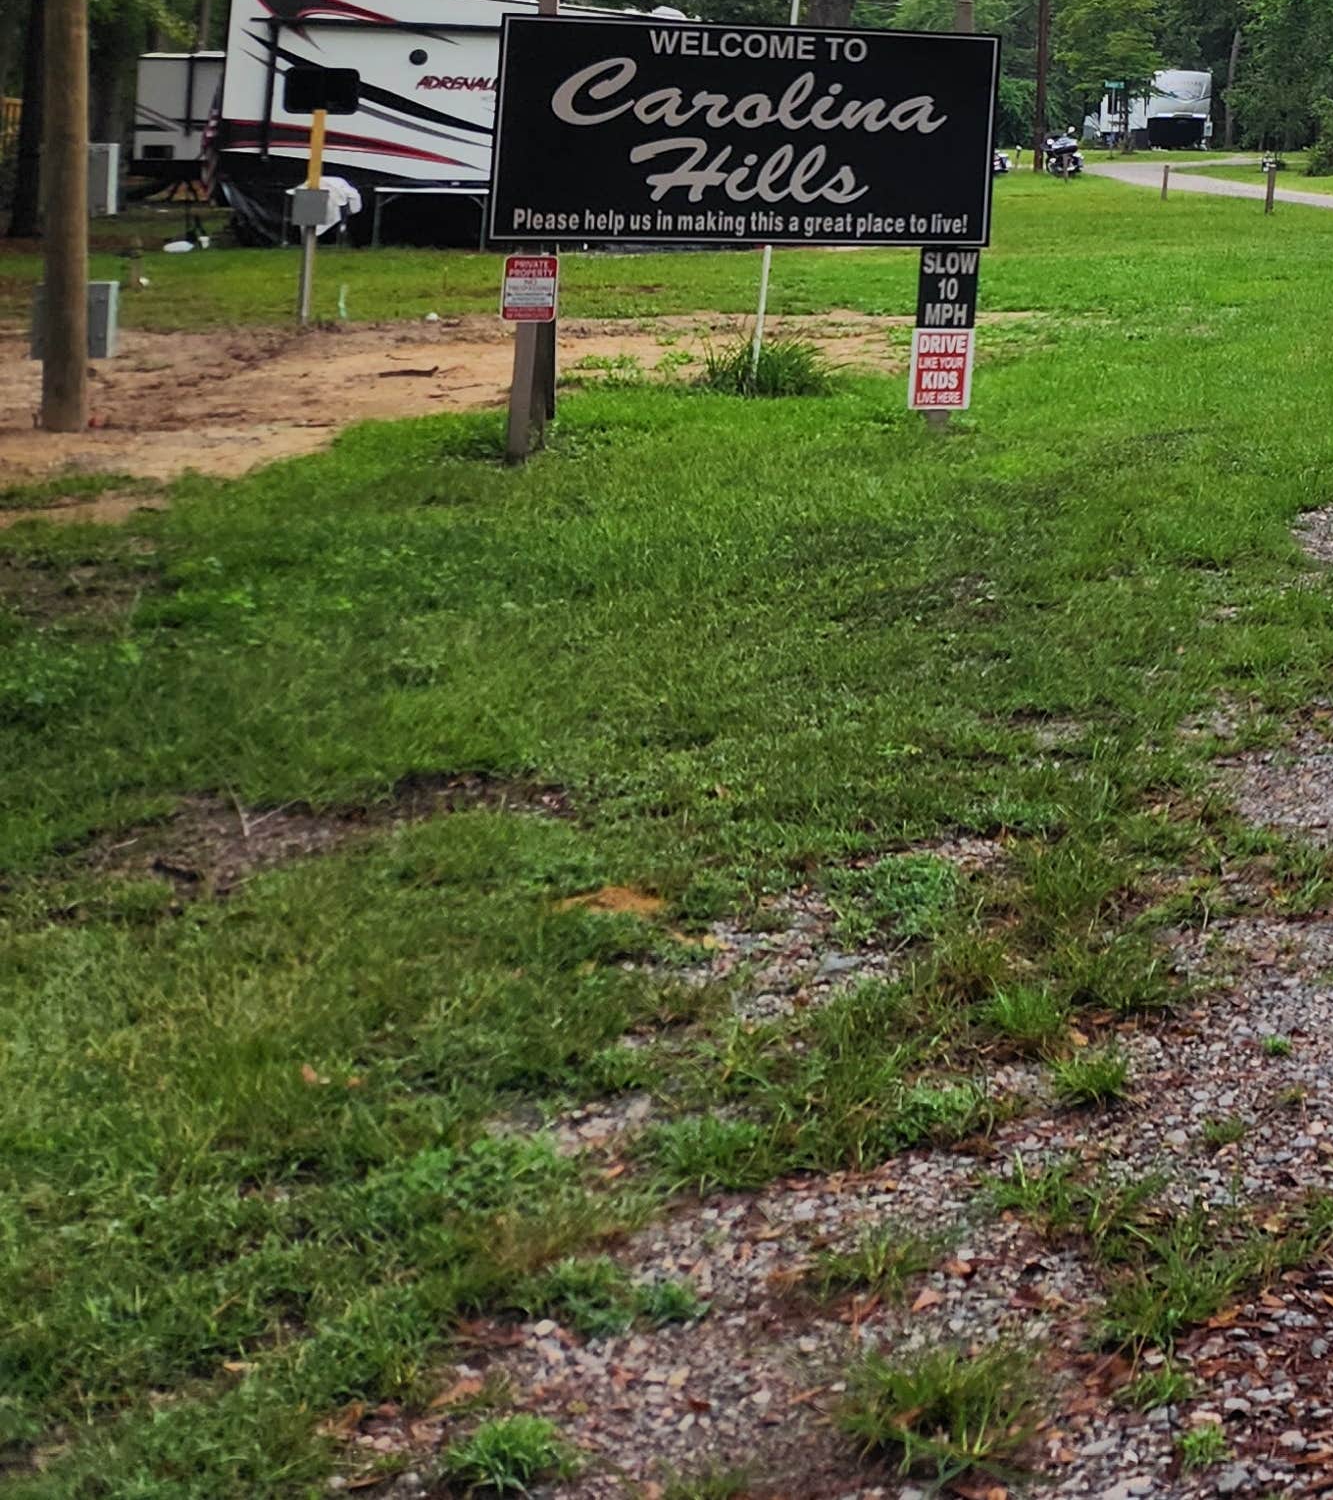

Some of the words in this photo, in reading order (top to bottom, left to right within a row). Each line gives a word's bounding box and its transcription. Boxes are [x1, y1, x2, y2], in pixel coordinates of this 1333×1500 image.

[650, 30, 816, 60] WELCOME
[825, 38, 868, 62] TO
[551, 57, 949, 134] Carolina
[630, 137, 870, 203] Hills
[513, 208, 580, 230] Please
[584, 209, 625, 236] help
[630, 214, 651, 231] us
[656, 209, 673, 231] in
[677, 210, 746, 237] making
[750, 211, 784, 232] this
[788, 215, 799, 232] a
[804, 213, 853, 237] great
[856, 212, 905, 238] place
[909, 214, 928, 233] to
[931, 213, 969, 234] live!
[509, 269, 553, 277] PROPERTY
[514, 260, 549, 269] PRIVATE
[923, 252, 978, 275] SLOW
[938, 278, 958, 300] 10
[924, 303, 968, 326] MPH
[919, 334, 967, 354] DRIVE
[918, 356, 938, 369] LIKE
[940, 356, 963, 369] YOUR
[921, 371, 958, 390] KIDS
[917, 391, 936, 405] LIVE
[937, 391, 961, 404] HERE
